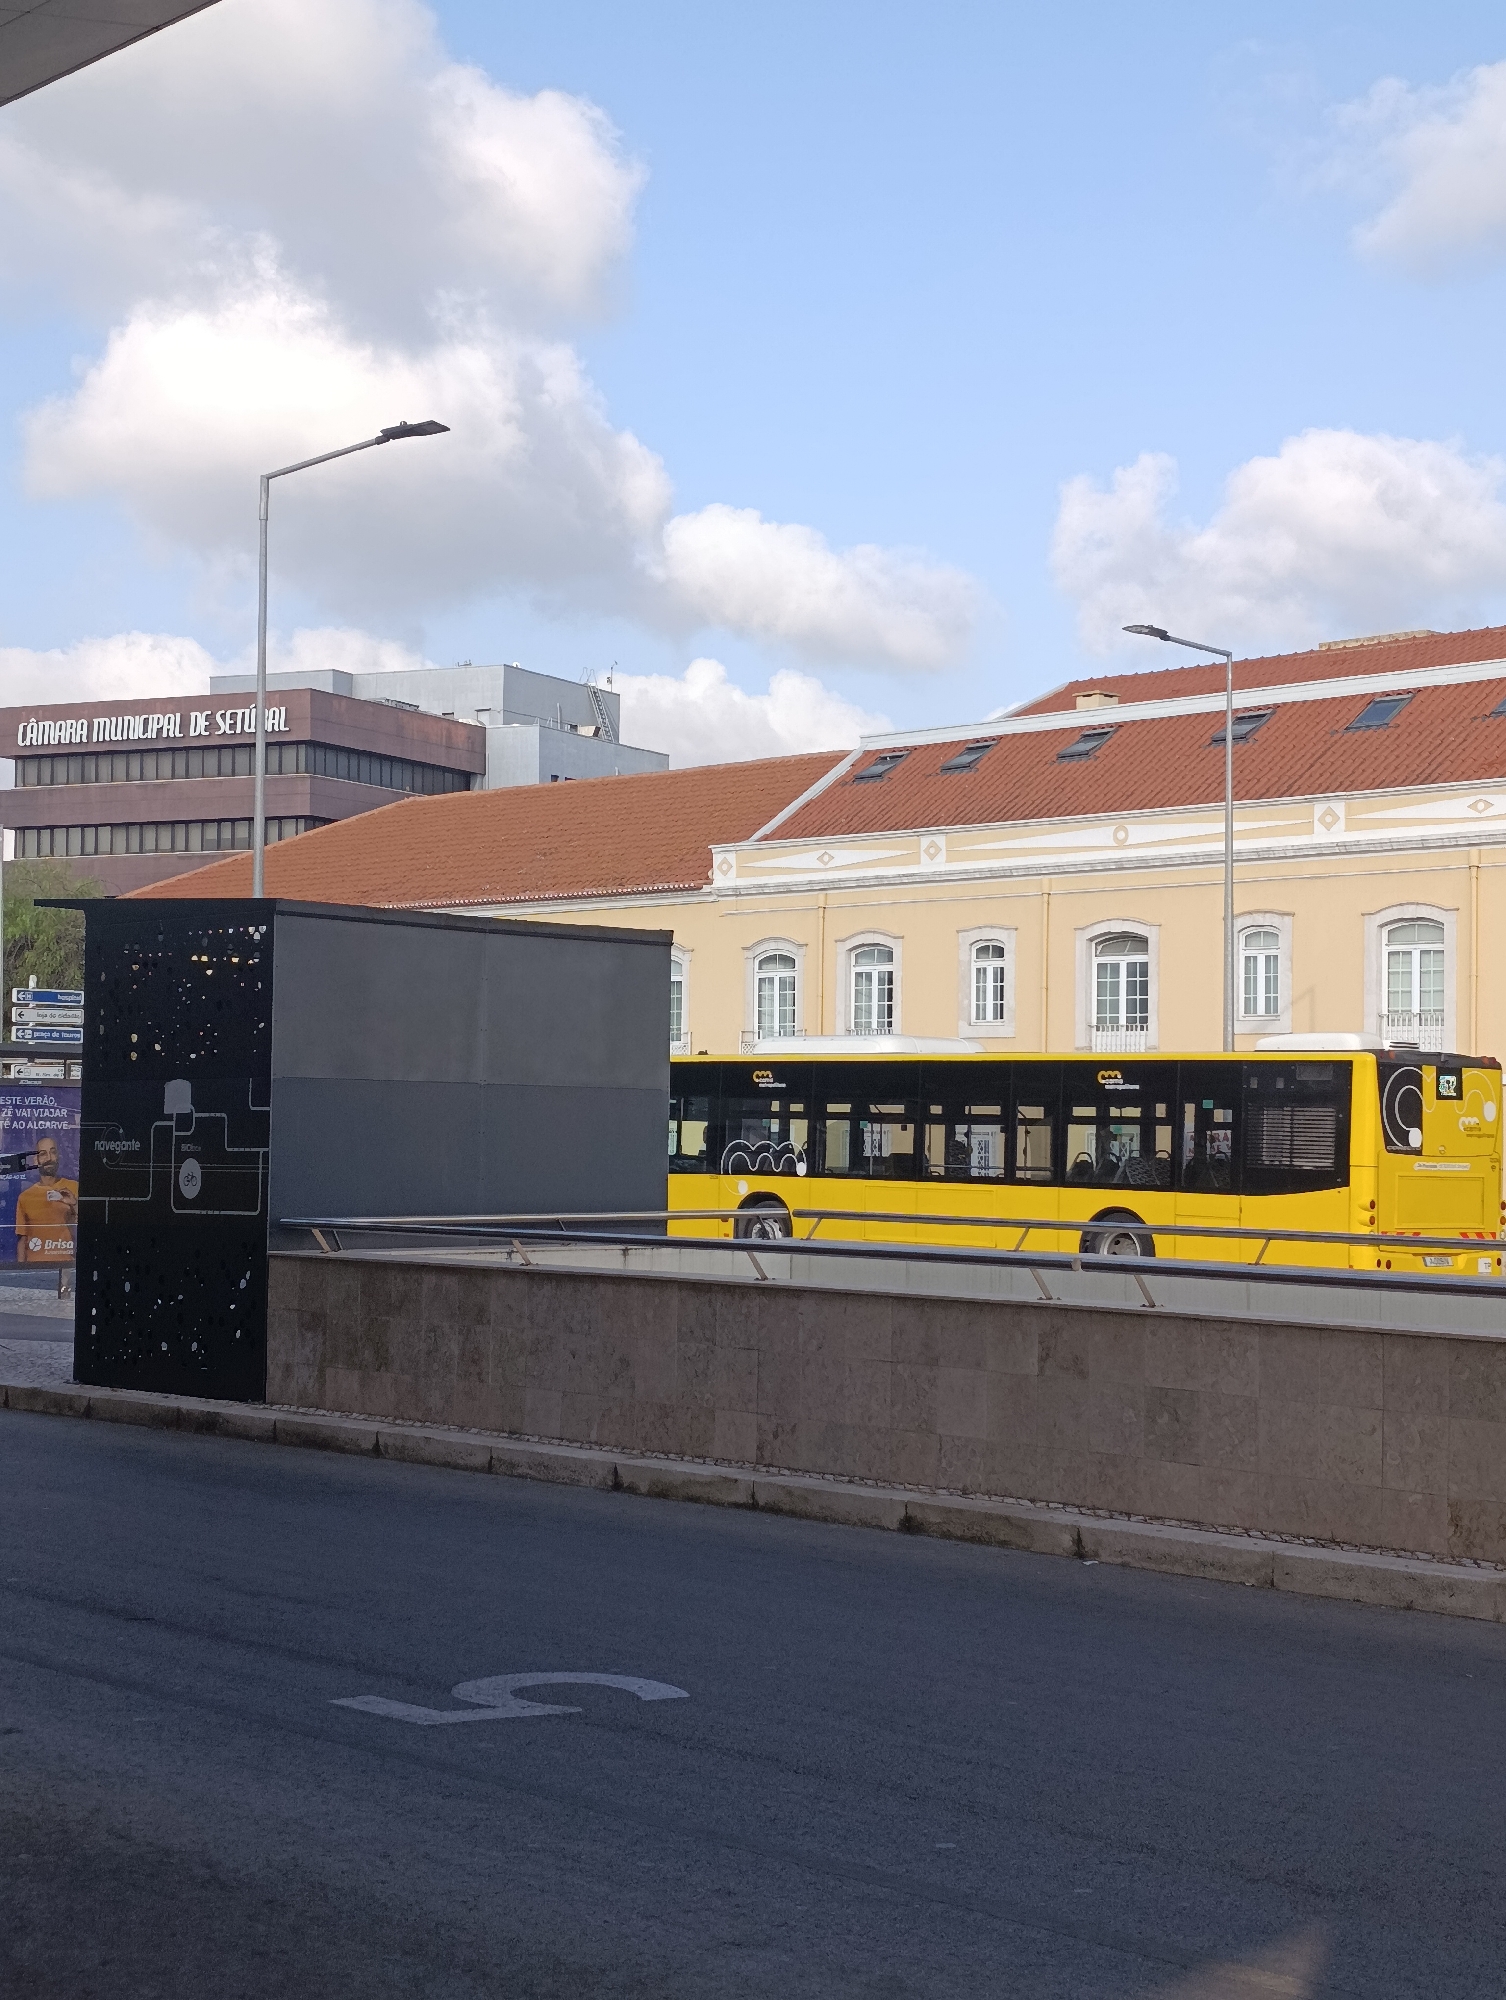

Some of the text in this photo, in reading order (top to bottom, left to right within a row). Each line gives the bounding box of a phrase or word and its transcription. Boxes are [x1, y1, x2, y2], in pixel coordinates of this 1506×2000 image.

[17, 717, 88, 747] CÂMARA
[92, 712, 184, 743] MUNICIPAL
[189, 710, 212, 737] DE
[0, 1094, 57, 1107] ESTE VERÃO,
[15, 1108, 32, 1118] VAI
[32, 1108, 68, 1118] VIAJAR
[12, 1120, 26, 1130] AO
[94, 1138, 141, 1154] navegante
[44, 1238, 74, 1249] Brisa
